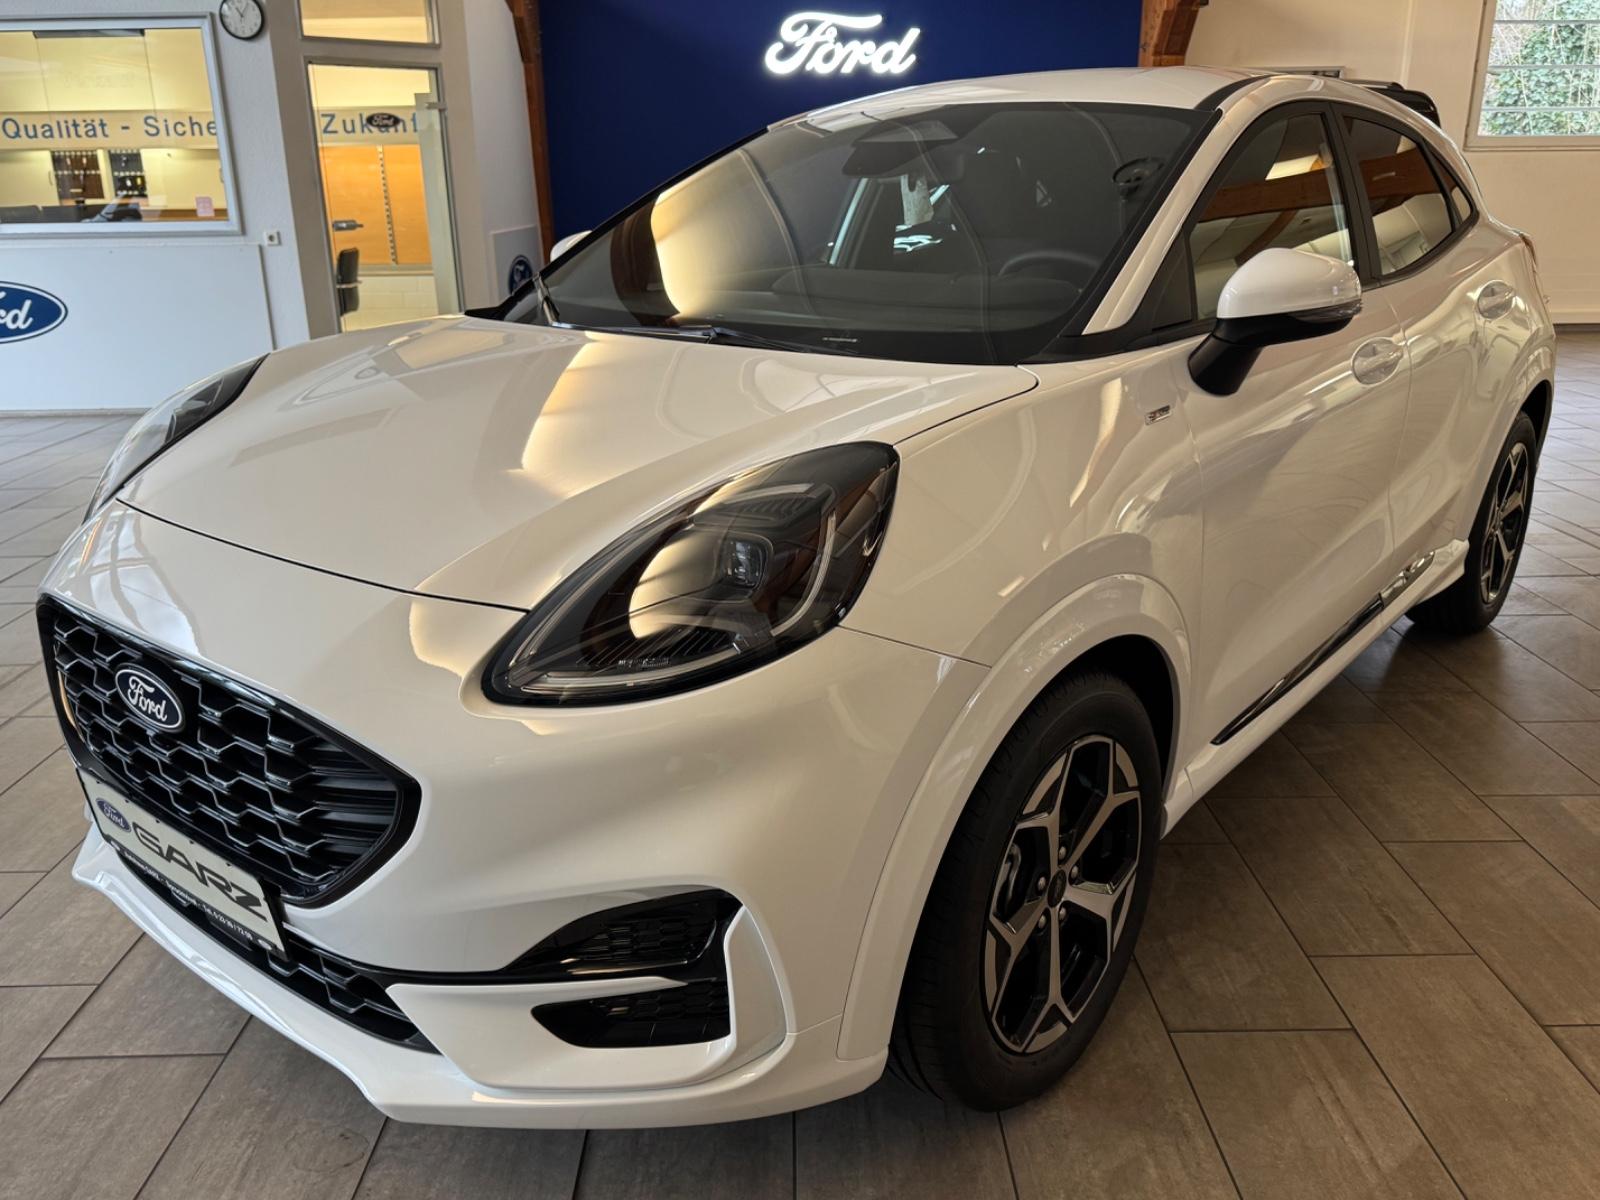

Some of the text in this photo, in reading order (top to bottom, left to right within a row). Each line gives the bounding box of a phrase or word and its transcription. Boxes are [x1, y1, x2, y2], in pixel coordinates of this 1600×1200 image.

[764, 11, 921, 75] Ford
[2, 118, 109, 139] Qualität
[127, 674, 168, 724] Ford
[103, 802, 126, 829] Ford
[132, 821, 268, 923] GARZ
